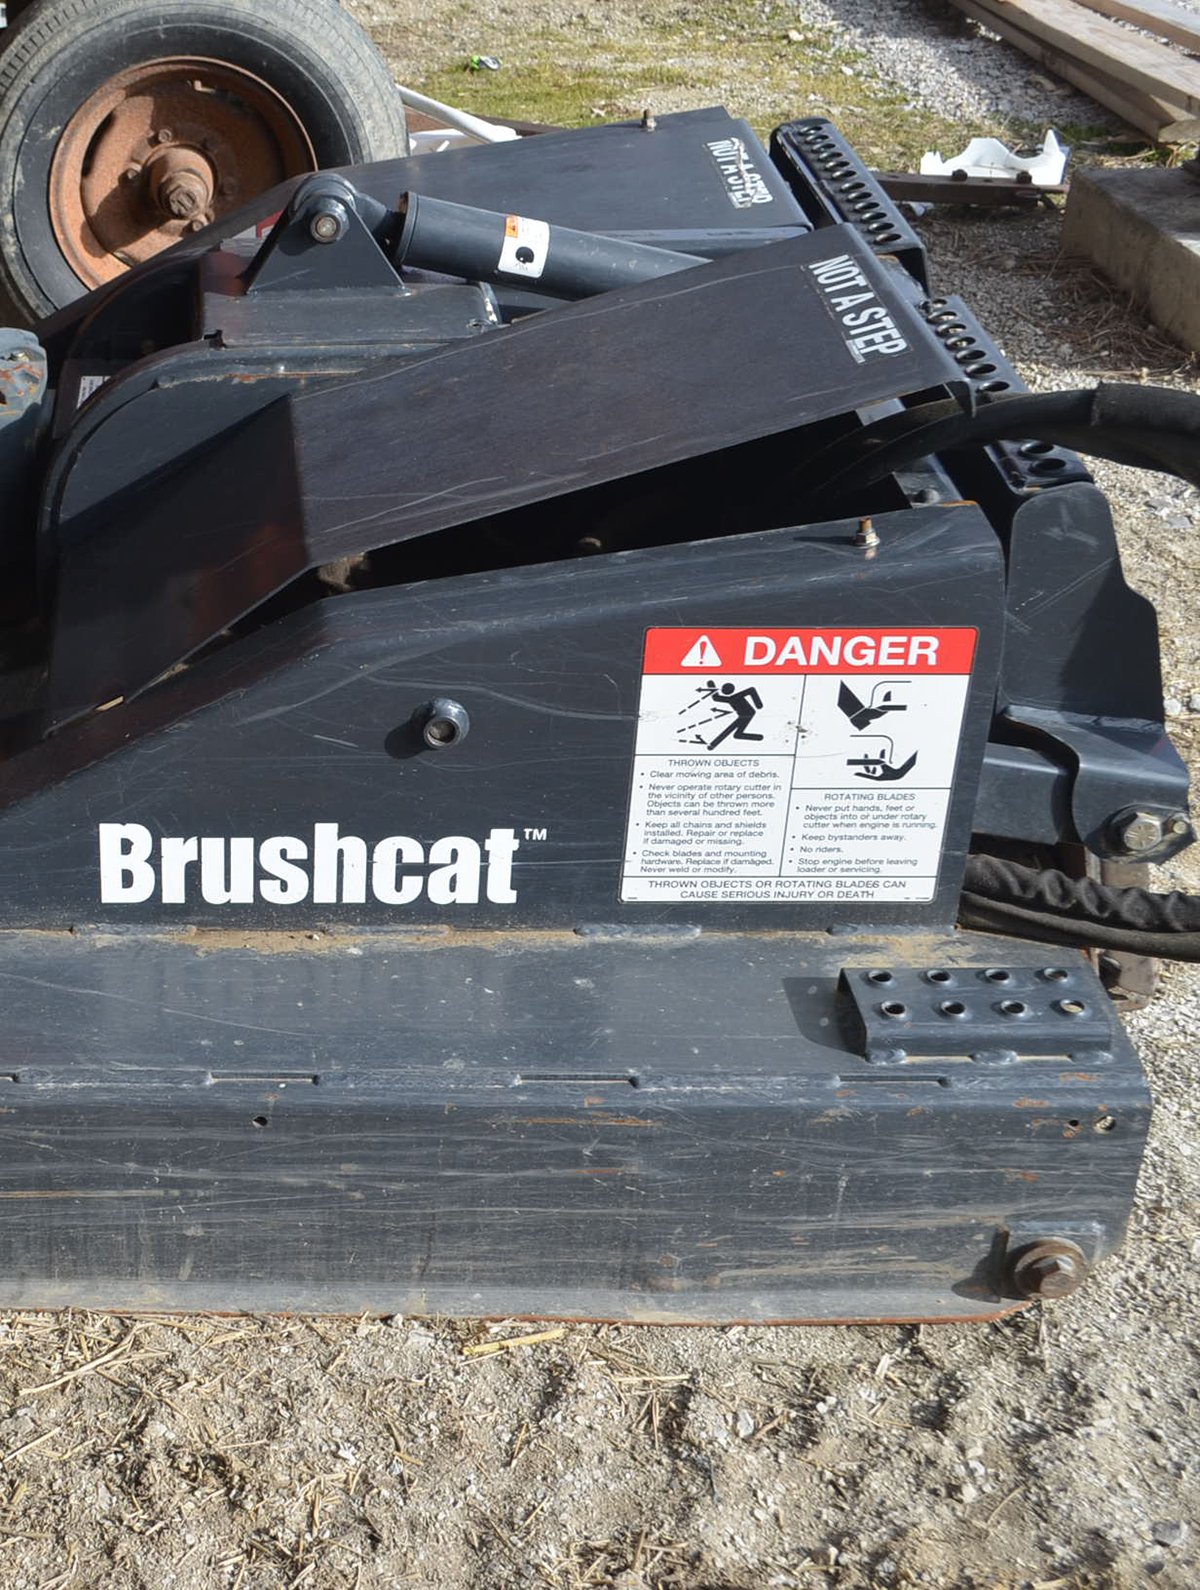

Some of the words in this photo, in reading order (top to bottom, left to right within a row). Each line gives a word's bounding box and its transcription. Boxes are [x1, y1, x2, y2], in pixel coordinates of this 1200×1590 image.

[808, 254, 867, 293] NOT
[831, 292, 874, 312] A
[842, 307, 907, 354] STEP
[743, 636, 939, 666] DANGER
[668, 759, 711, 767] THROWN
[714, 759, 760, 767] OBJECTS
[664, 792, 696, 800] vicinity
[824, 793, 875, 801] ROTATING
[878, 793, 915, 801] BLADES
[647, 800, 681, 809] Objects
[703, 800, 714, 808] be
[717, 800, 748, 808] thrown
[835, 805, 849, 813] put
[804, 813, 837, 821] objects
[901, 813, 927, 821] rotary
[686, 830, 715, 838] Repair
[730, 830, 763, 838] replace
[802, 834, 825, 842] Keep
[828, 834, 878, 842] bystanders
[651, 838, 693, 846] damaged
[98, 823, 519, 904] Brushcat
[686, 858, 720, 866] Replace
[731, 858, 774, 866] damaged.
[798, 858, 819, 866] Stop
[776, 880, 832, 888] ROTATING
[836, 880, 879, 888] BLADES
[883, 880, 906, 888] CAN
